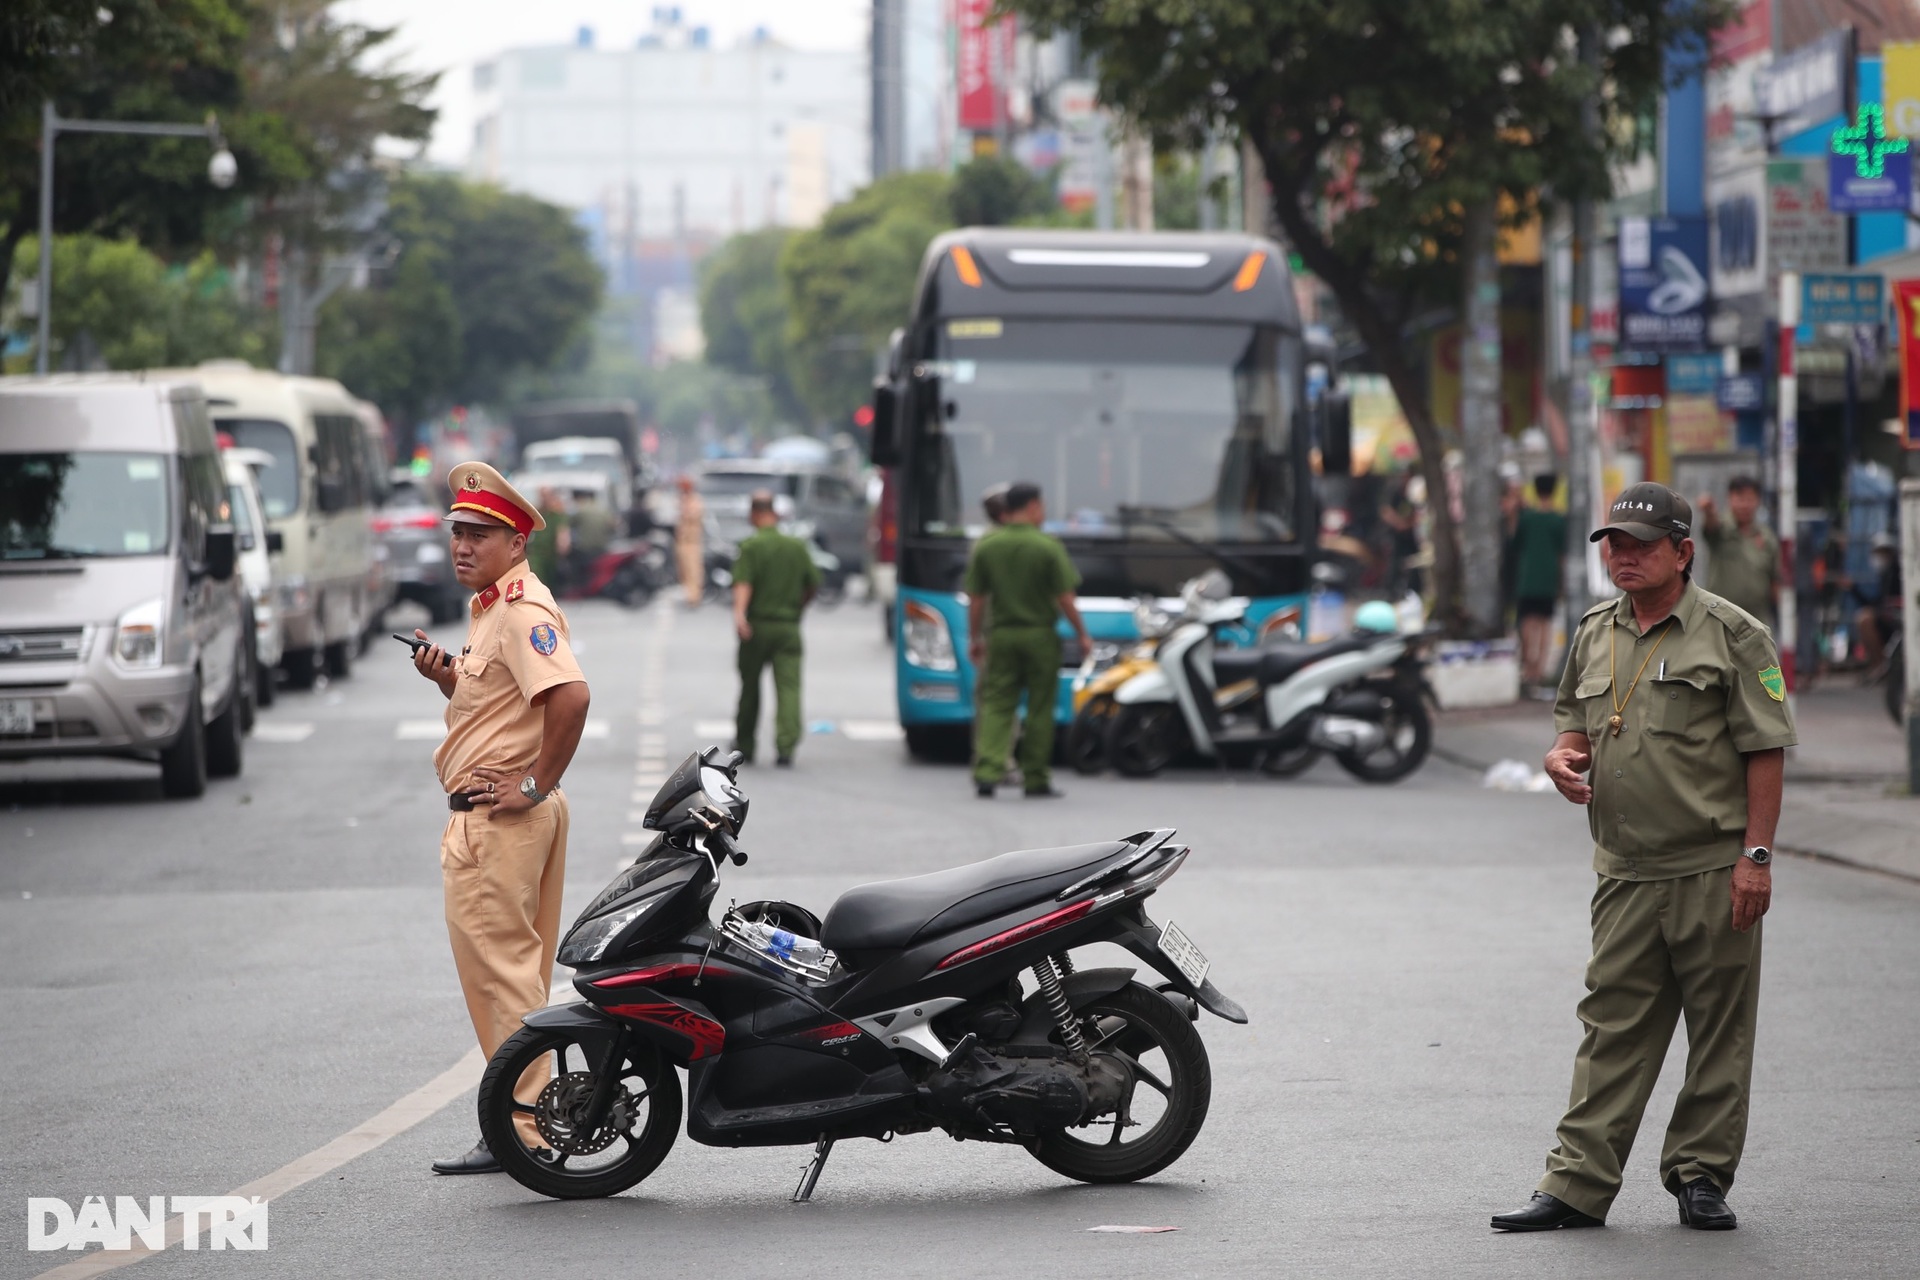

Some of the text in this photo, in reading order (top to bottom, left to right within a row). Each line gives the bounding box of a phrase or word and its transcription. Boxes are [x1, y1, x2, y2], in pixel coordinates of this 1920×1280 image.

[1612, 501, 1654, 512] TEELAB
[1163, 928, 1188, 961] 59-D2
[1181, 946, 1208, 984] 931.36
